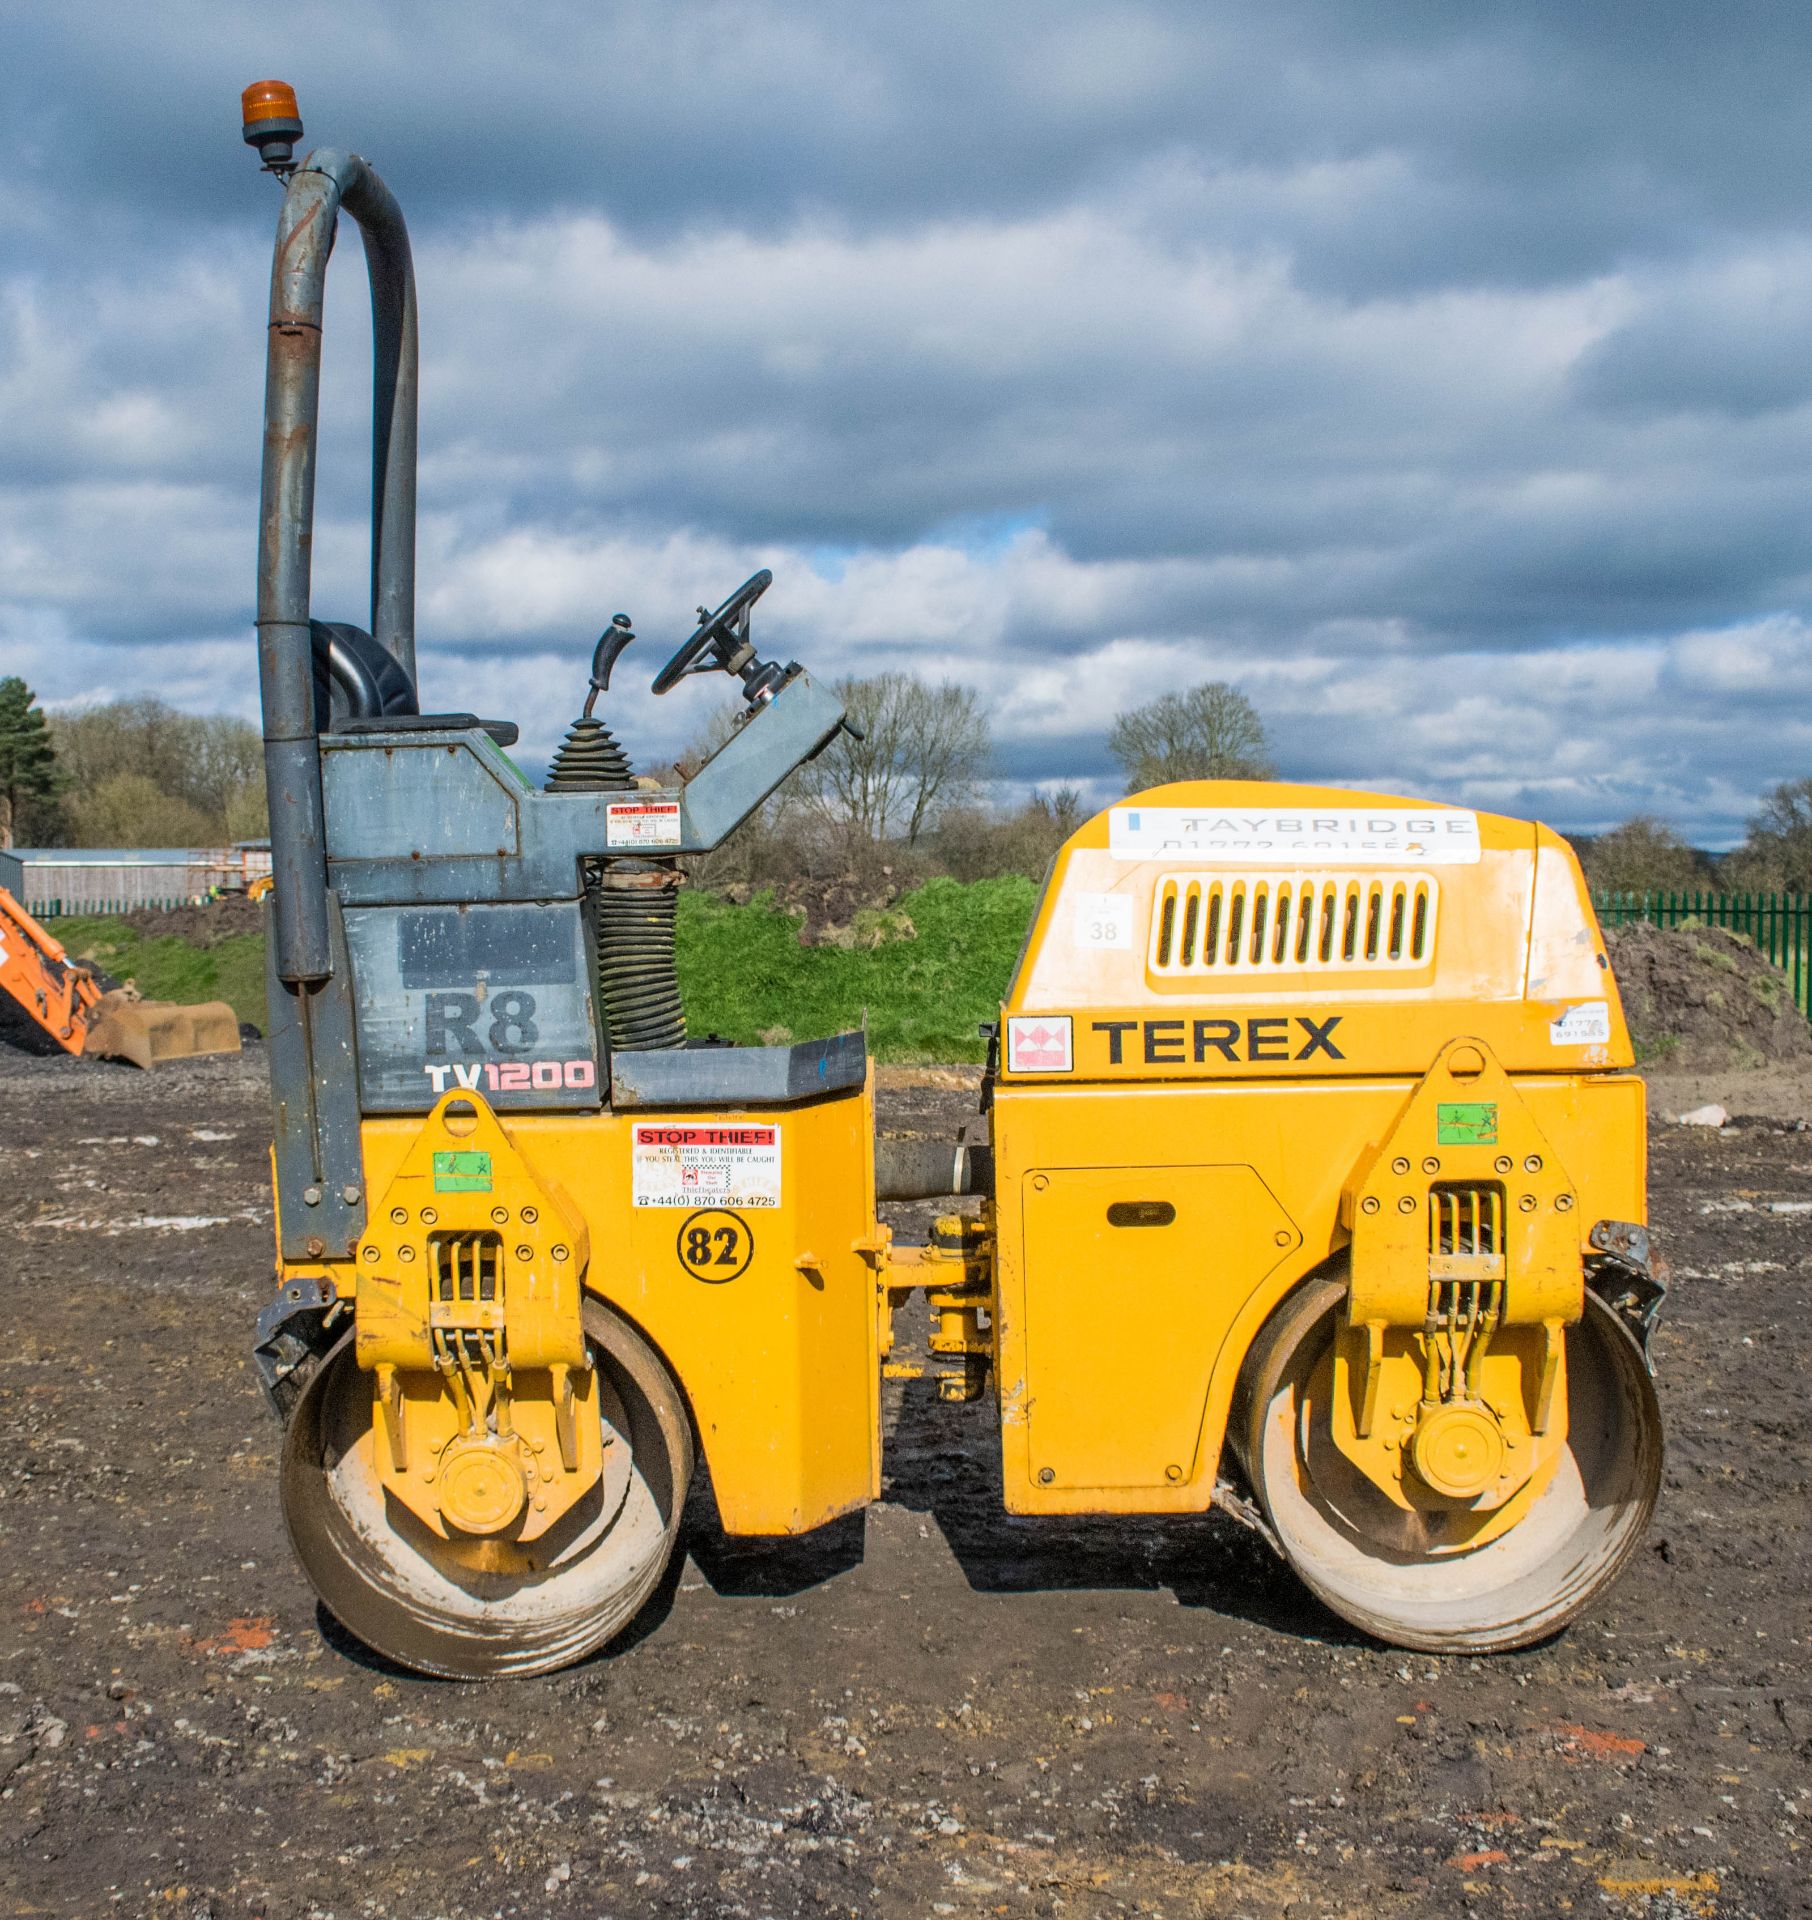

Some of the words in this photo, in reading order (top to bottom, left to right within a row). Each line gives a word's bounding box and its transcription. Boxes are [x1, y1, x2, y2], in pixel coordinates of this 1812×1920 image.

[1181, 818, 1473, 834] TAYBRIDGE
[1090, 921, 1117, 941] 38
[425, 990, 539, 1055] R8
[1092, 1017, 1347, 1064] TEREX
[424, 1060, 595, 1092] TV1200
[640, 1131, 697, 1144] STOP
[705, 1130, 773, 1144] THIEF!
[652, 1195, 690, 1206] +44(0)
[694, 1196, 716, 1206] 870
[720, 1196, 743, 1206] 606
[747, 1196, 776, 1206] 4725
[687, 1227, 738, 1266] 82
